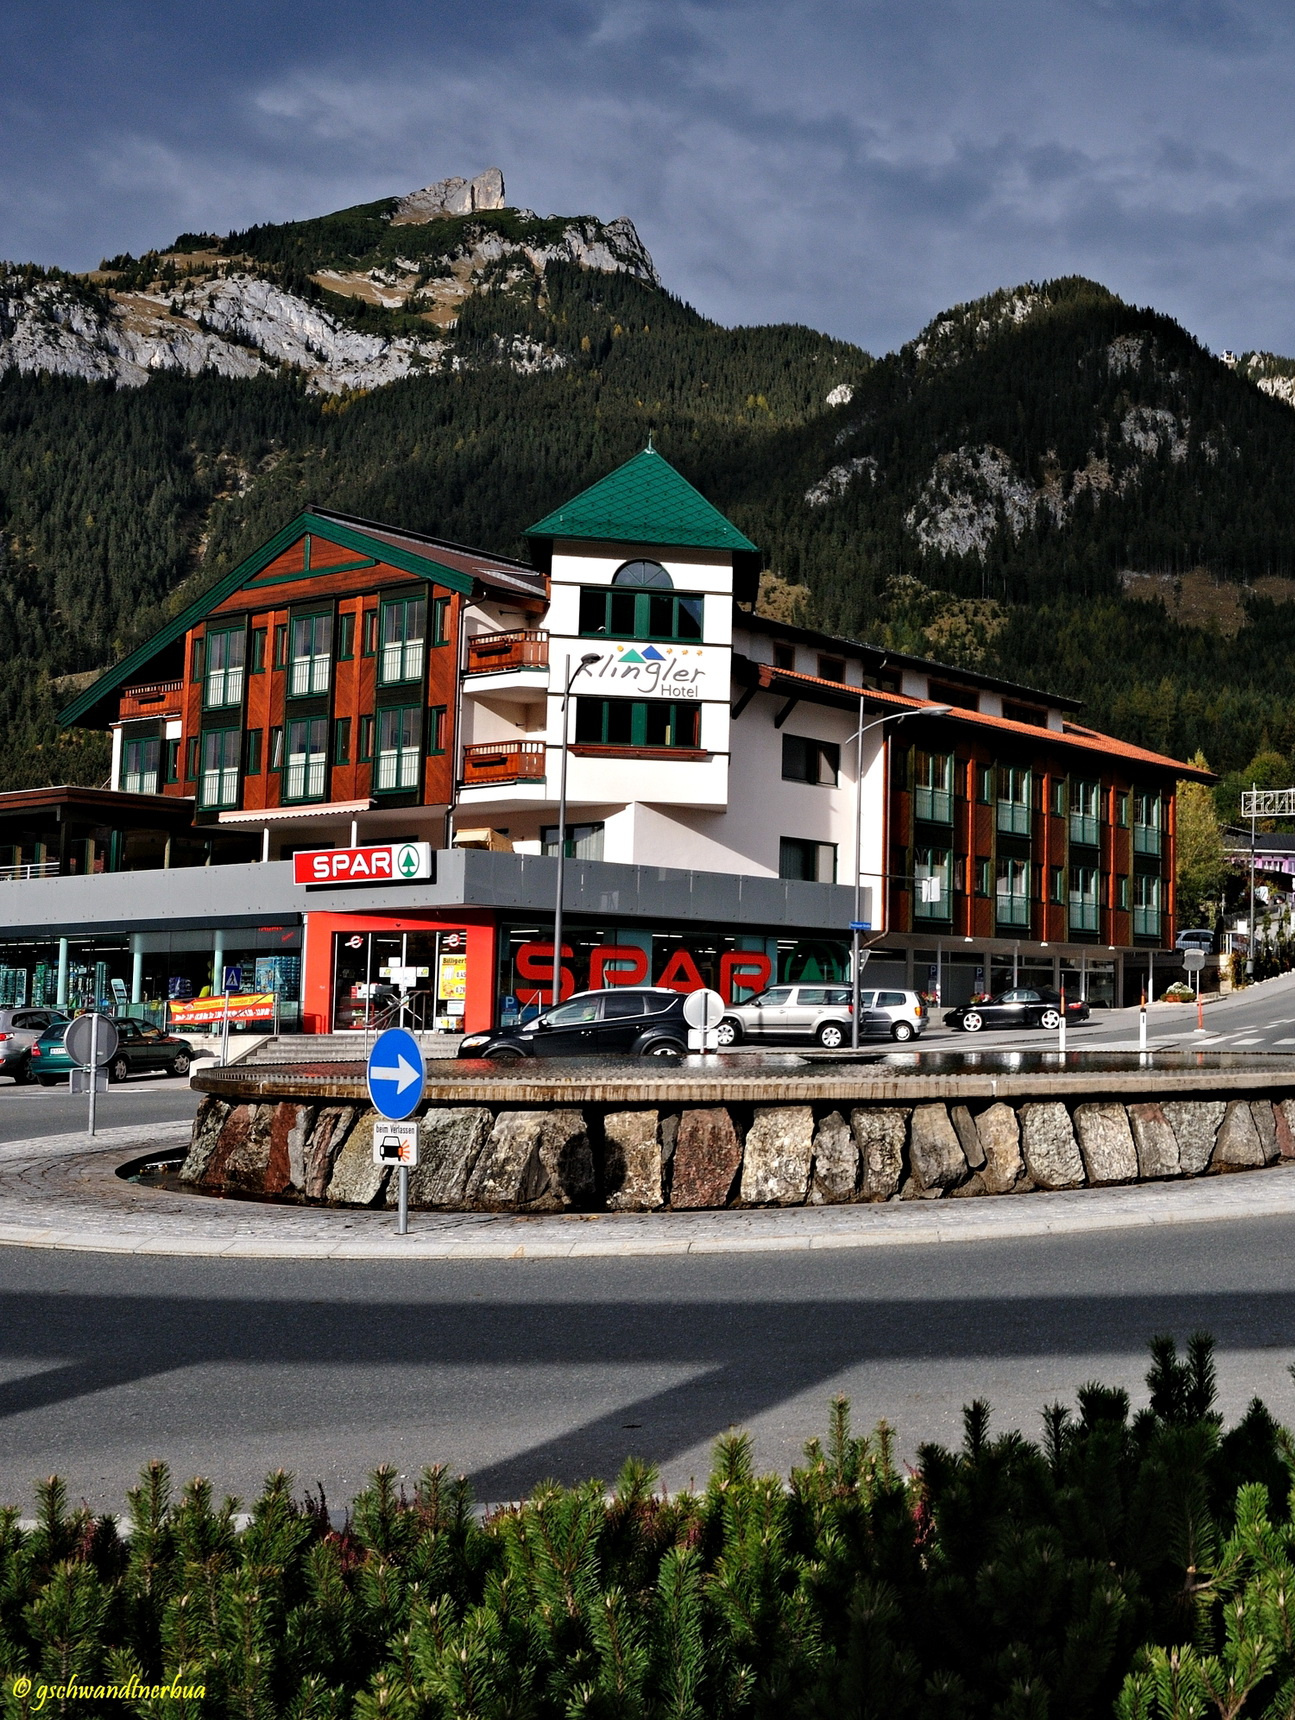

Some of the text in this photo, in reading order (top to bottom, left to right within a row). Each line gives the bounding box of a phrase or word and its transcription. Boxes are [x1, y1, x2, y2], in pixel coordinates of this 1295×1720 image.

[577, 654, 705, 693] Klingler
[661, 684, 698, 698] Hotel
[313, 854, 391, 879] SPAR
[515, 941, 772, 1006] SPAR
[390, 1125, 415, 1134] Verlassen
